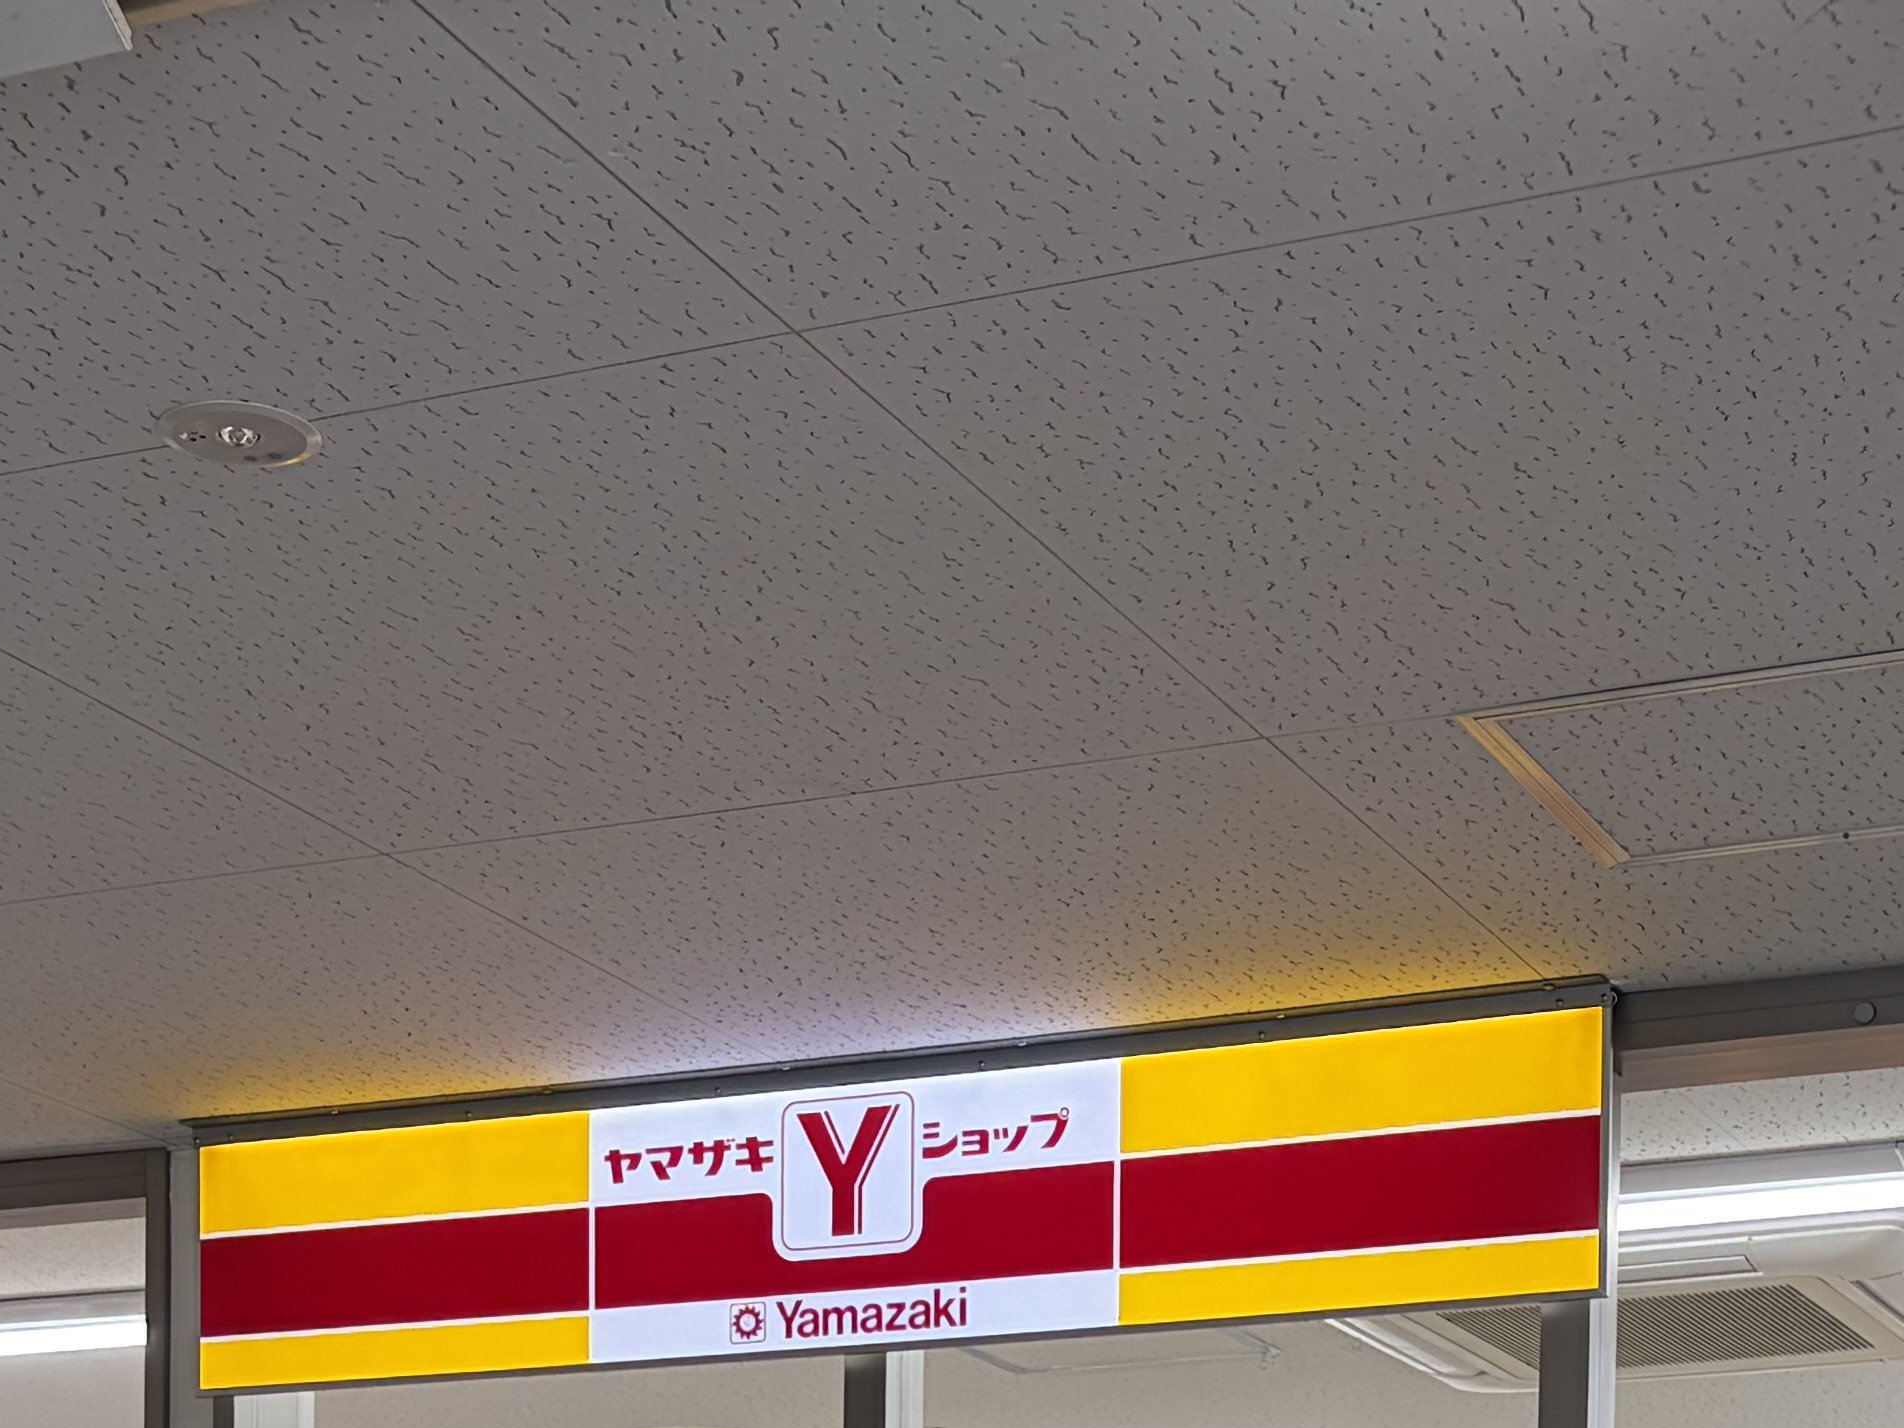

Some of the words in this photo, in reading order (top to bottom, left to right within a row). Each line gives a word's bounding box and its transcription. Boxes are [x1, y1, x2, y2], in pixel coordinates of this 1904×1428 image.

[604, 1137, 774, 1184] ヤマザキ
[797, 1104, 900, 1236] Y
[923, 1107, 1069, 1159] ショップ
[776, 1287, 967, 1339] Yamazaki
